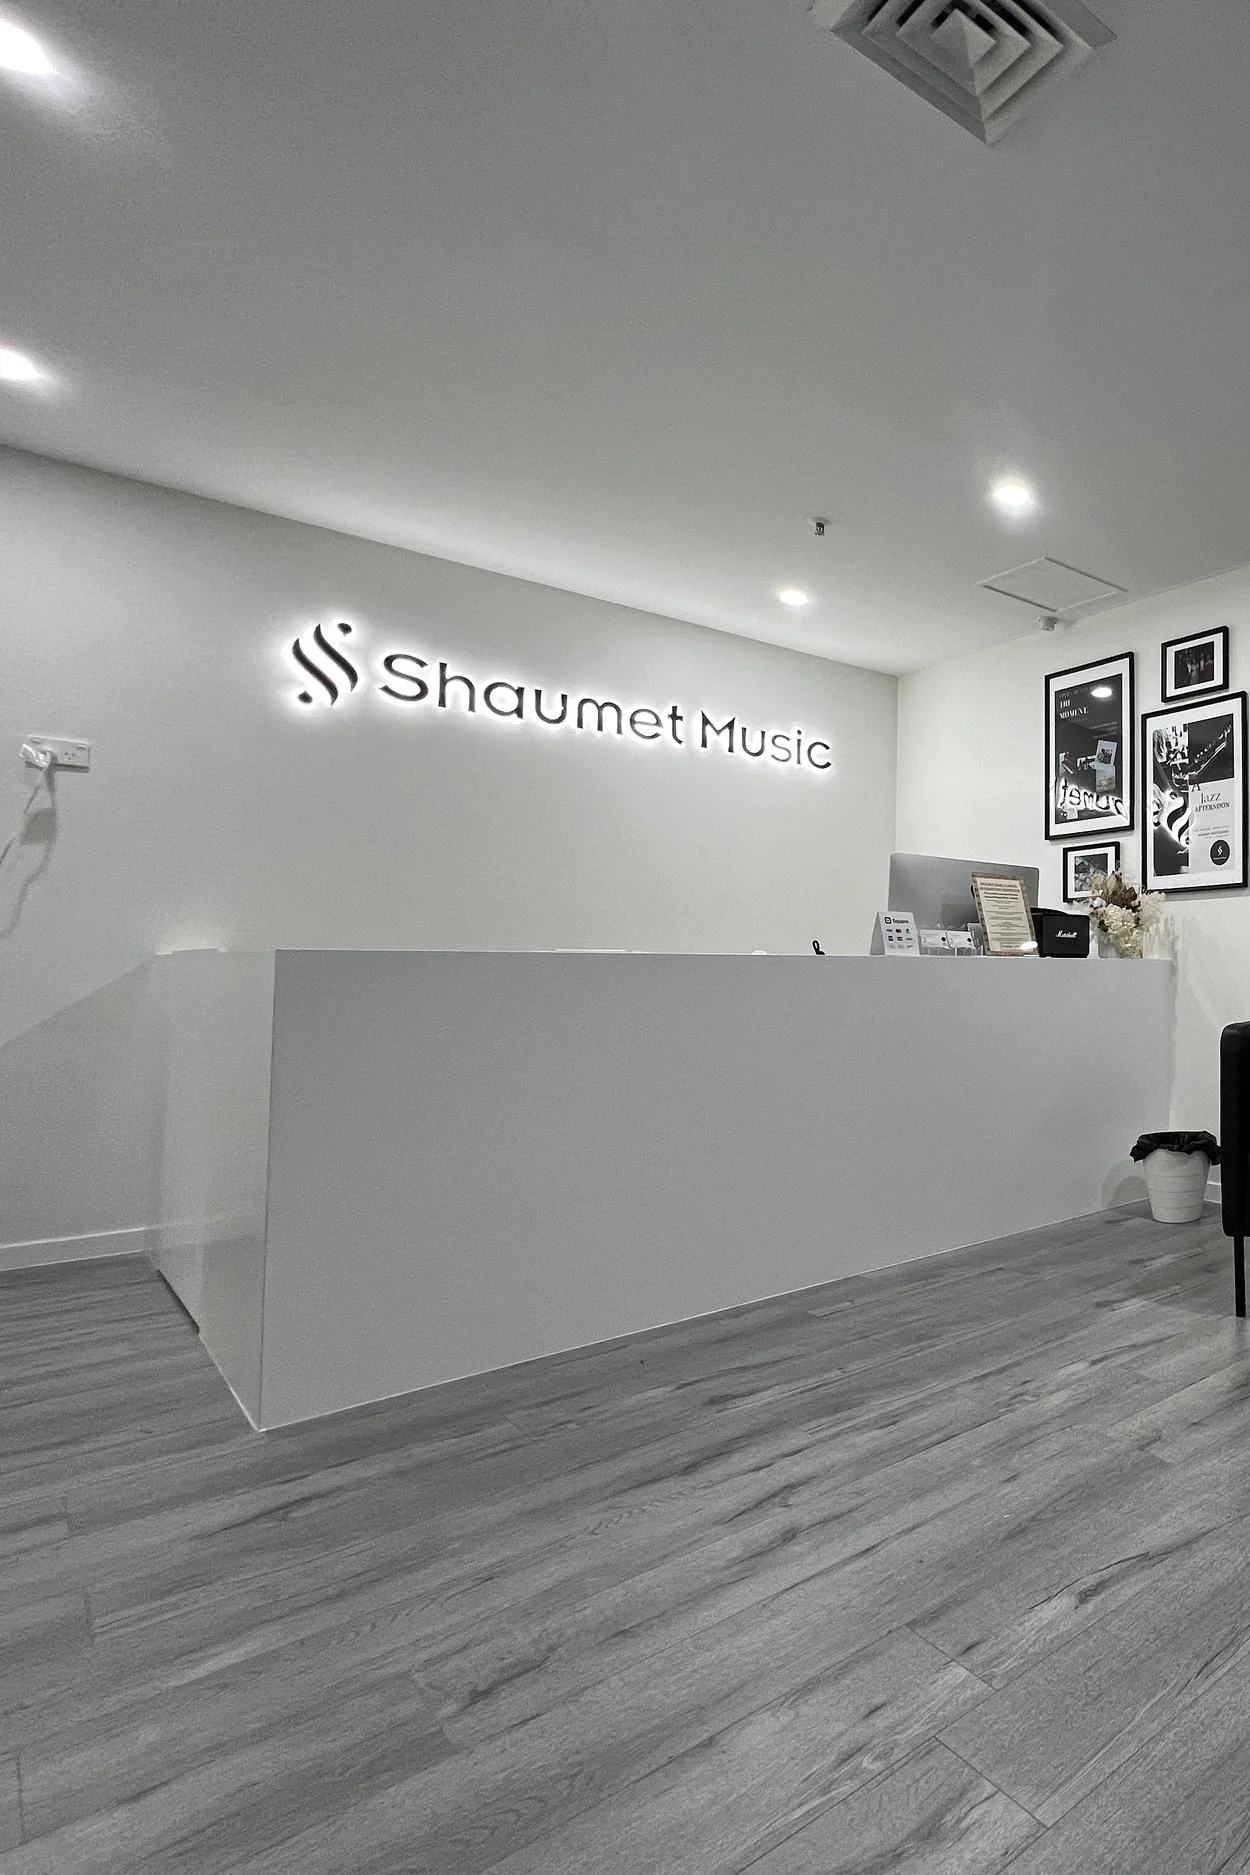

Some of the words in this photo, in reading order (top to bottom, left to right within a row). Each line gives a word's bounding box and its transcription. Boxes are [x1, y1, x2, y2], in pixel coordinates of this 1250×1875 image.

[379, 653, 683, 746] Shaumet
[700, 709, 832, 770] Music
[1201, 792, 1221, 804] Jazz
[1195, 801, 1231, 813] AFTERNOON
